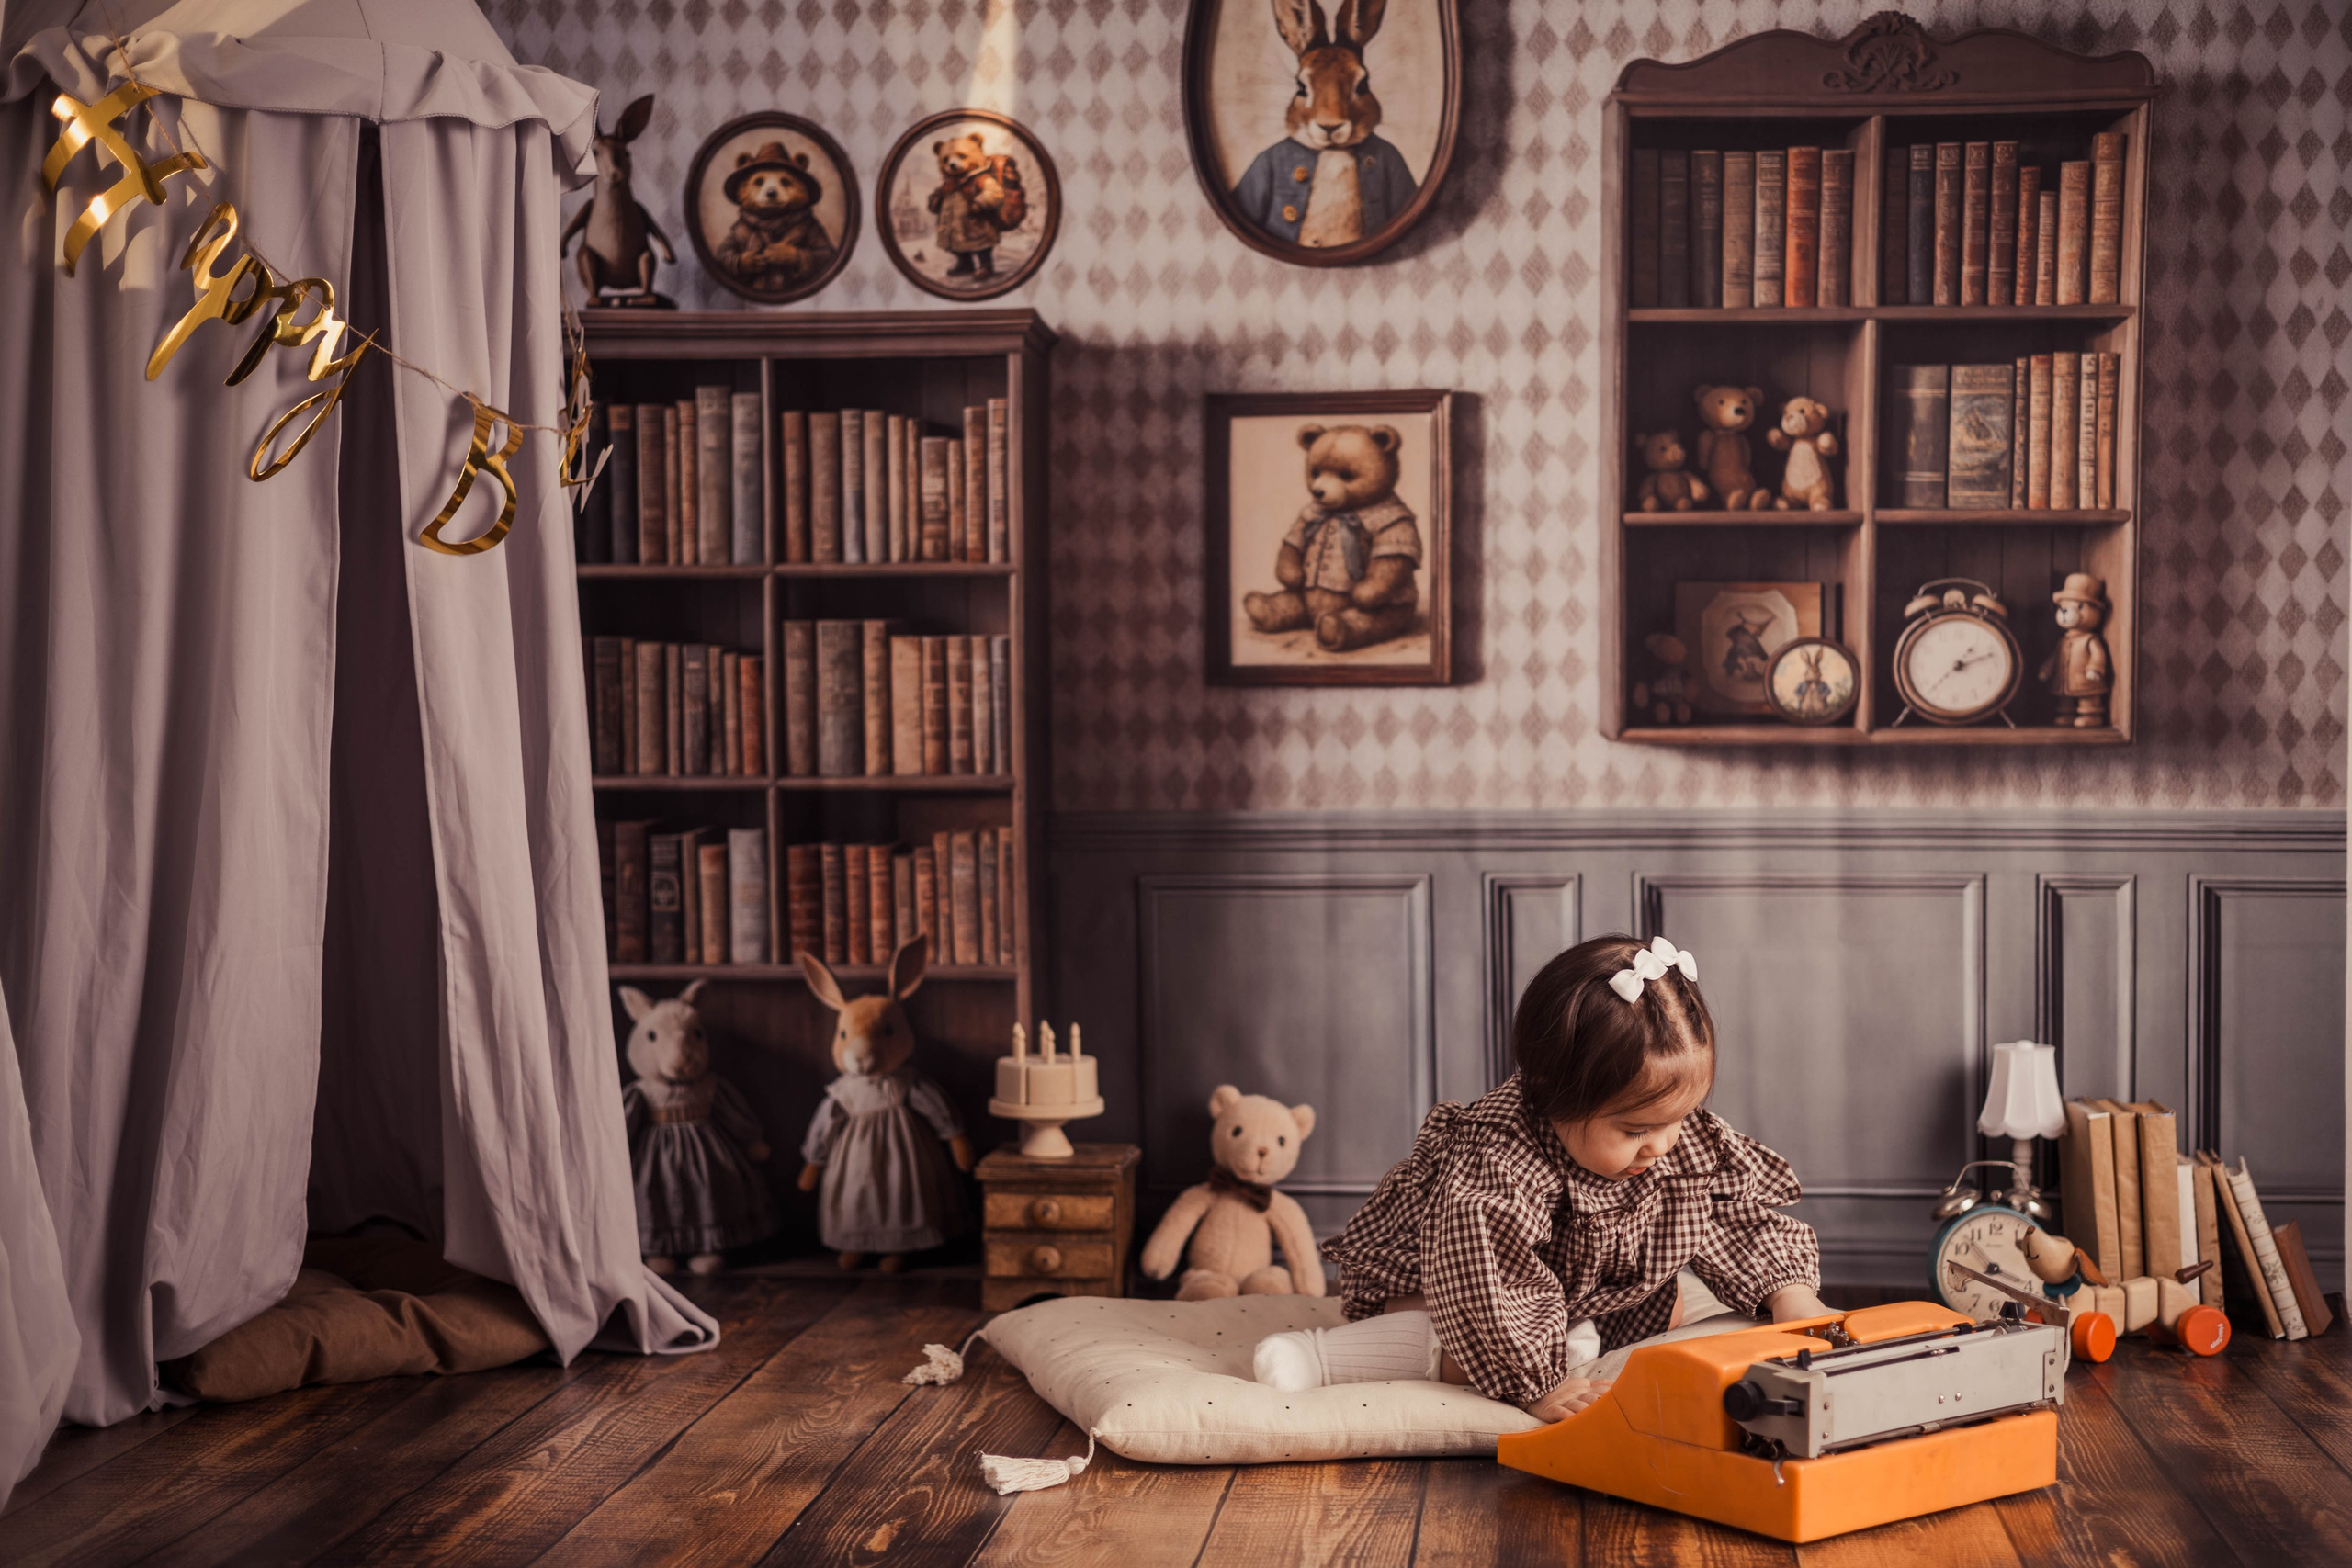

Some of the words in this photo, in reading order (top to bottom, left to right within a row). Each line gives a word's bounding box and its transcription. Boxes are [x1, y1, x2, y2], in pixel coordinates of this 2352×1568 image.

[1970, 1228, 1982, 1241] 11
[1989, 1221, 2003, 1236] 12
[1954, 1241, 1970, 1256] 10
[2024, 1279, 2033, 1293] 4
[1972, 1293, 1982, 1308] 7
[1988, 1299, 2001, 1313] 6
